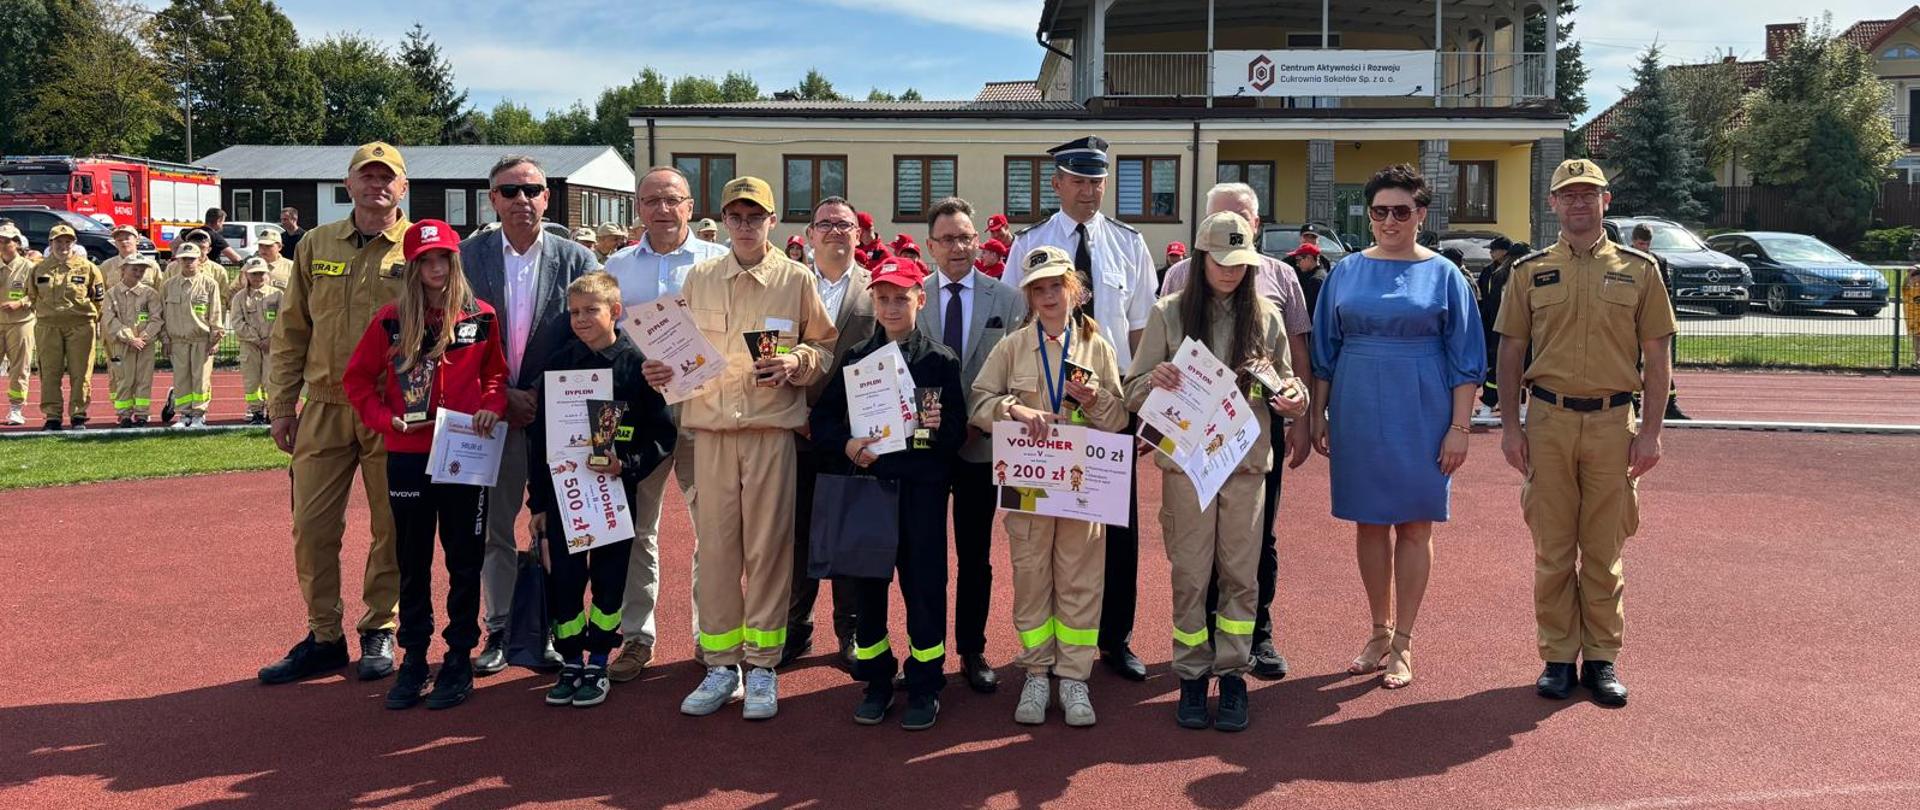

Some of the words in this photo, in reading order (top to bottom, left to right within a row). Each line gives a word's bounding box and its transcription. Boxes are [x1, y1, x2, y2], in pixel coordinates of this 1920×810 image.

[1280, 64, 1315, 72] Centrum
[1316, 63, 1361, 74] Aktywności
[1367, 64, 1401, 73] Rozwoju
[1280, 75, 1322, 83] Cukrownia
[1323, 74, 1357, 83] Sokołów
[1358, 75, 1371, 84] Sp.
[1187, 364, 1213, 386] DYPLOM
[564, 388, 594, 396] DYPLOM
[859, 379, 882, 389] DYPLOM
[1007, 437, 1073, 451] VOUCHER
[1085, 445, 1106, 459] 00
[1111, 449, 1124, 463] zł
[1012, 464, 1045, 479] 200
[1052, 466, 1066, 481] zł
[564, 477, 584, 511] 500
[475, 486, 485, 535] GIVOV
[597, 474, 617, 532] OUCHER
[572, 516, 591, 532] zł
